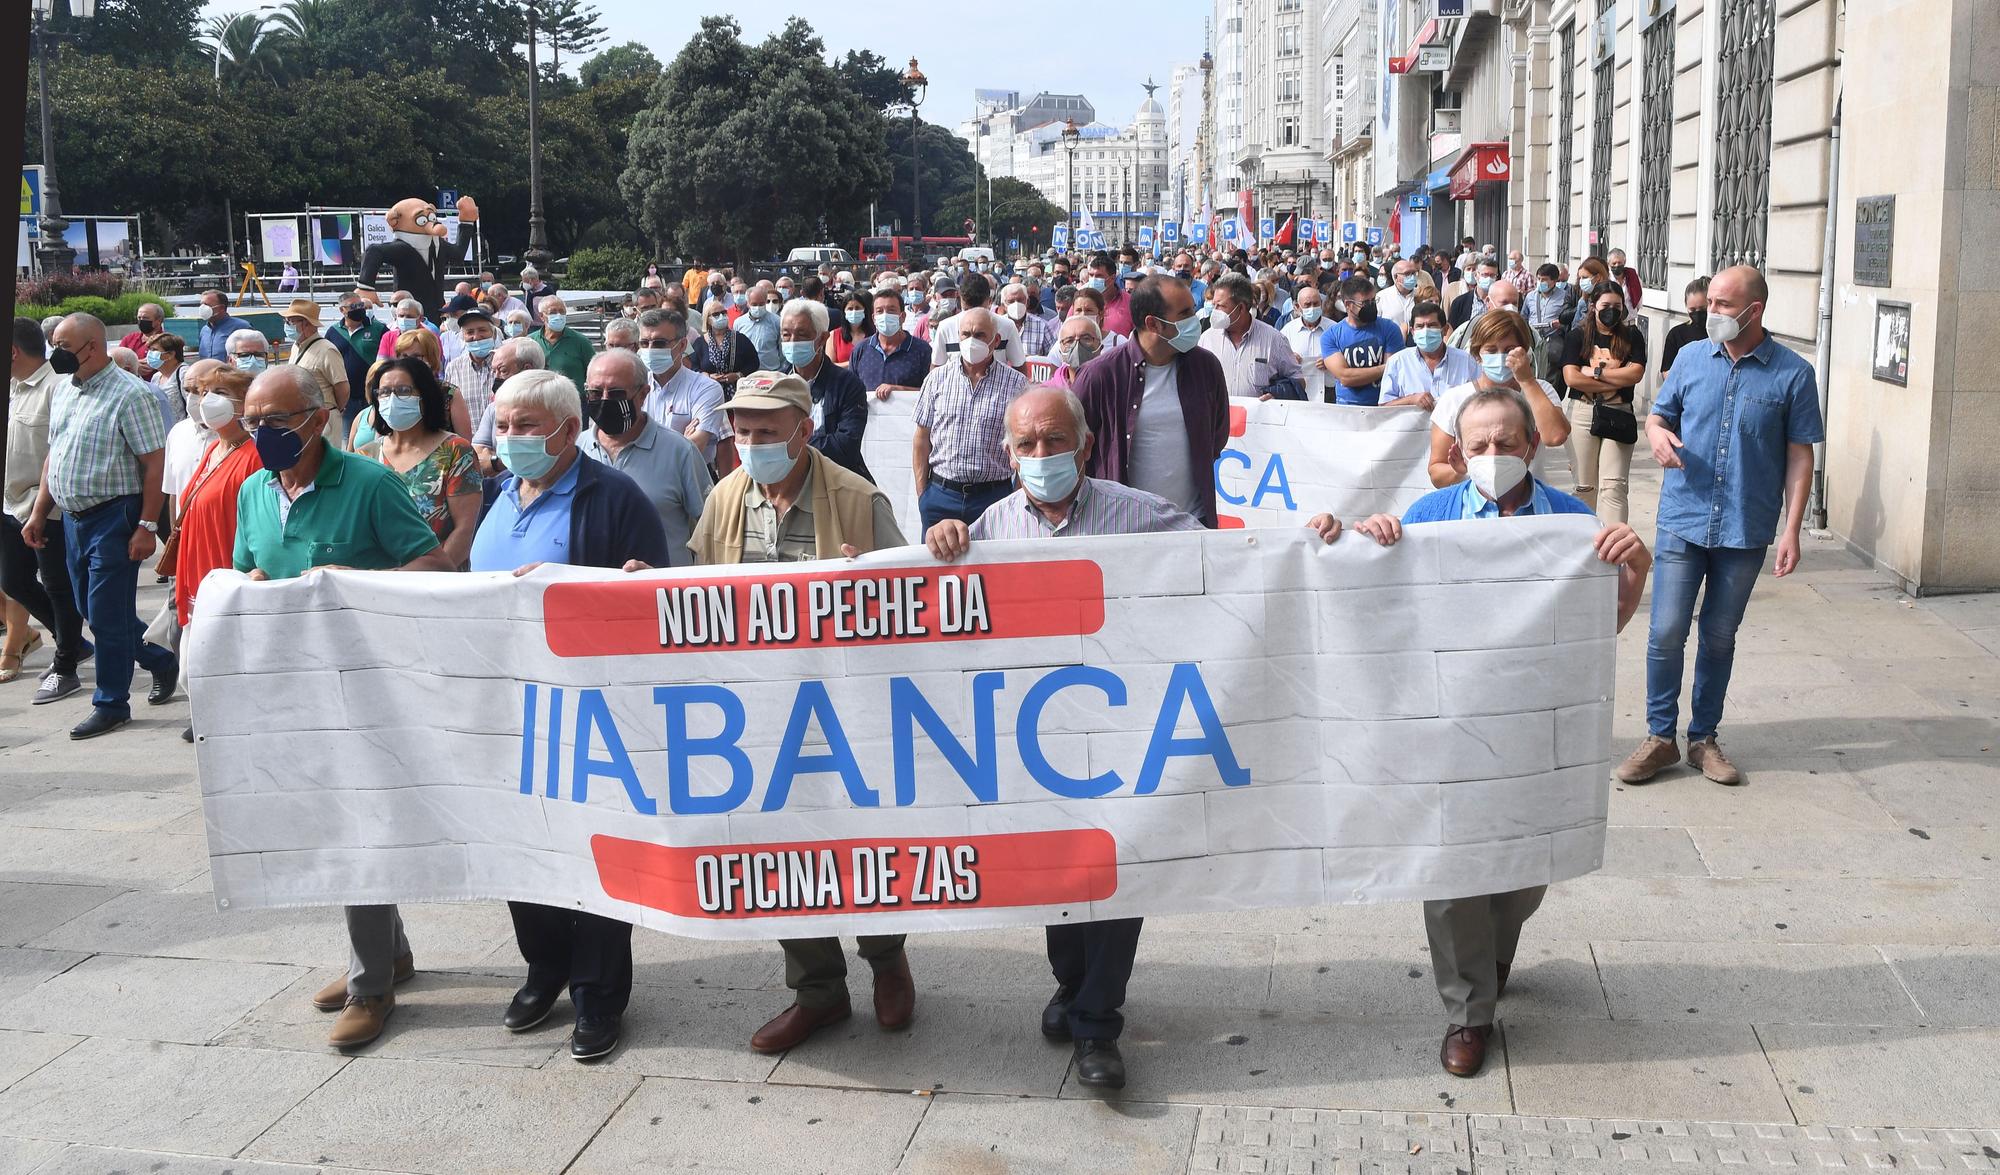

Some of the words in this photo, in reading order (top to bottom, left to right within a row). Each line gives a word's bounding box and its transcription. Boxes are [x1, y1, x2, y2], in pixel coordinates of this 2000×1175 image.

[367, 224, 386, 233] Galicia
[367, 233, 388, 243] Design
[656, 584, 736, 646] NON
[748, 582, 797, 642] AO
[808, 576, 927, 640] PECHE
[938, 573, 989, 634] DA
[520, 662, 1252, 816] ABANCA
[695, 849, 842, 912] OFICINA
[851, 846, 899, 906] DE
[908, 845, 978, 903] ZAS
